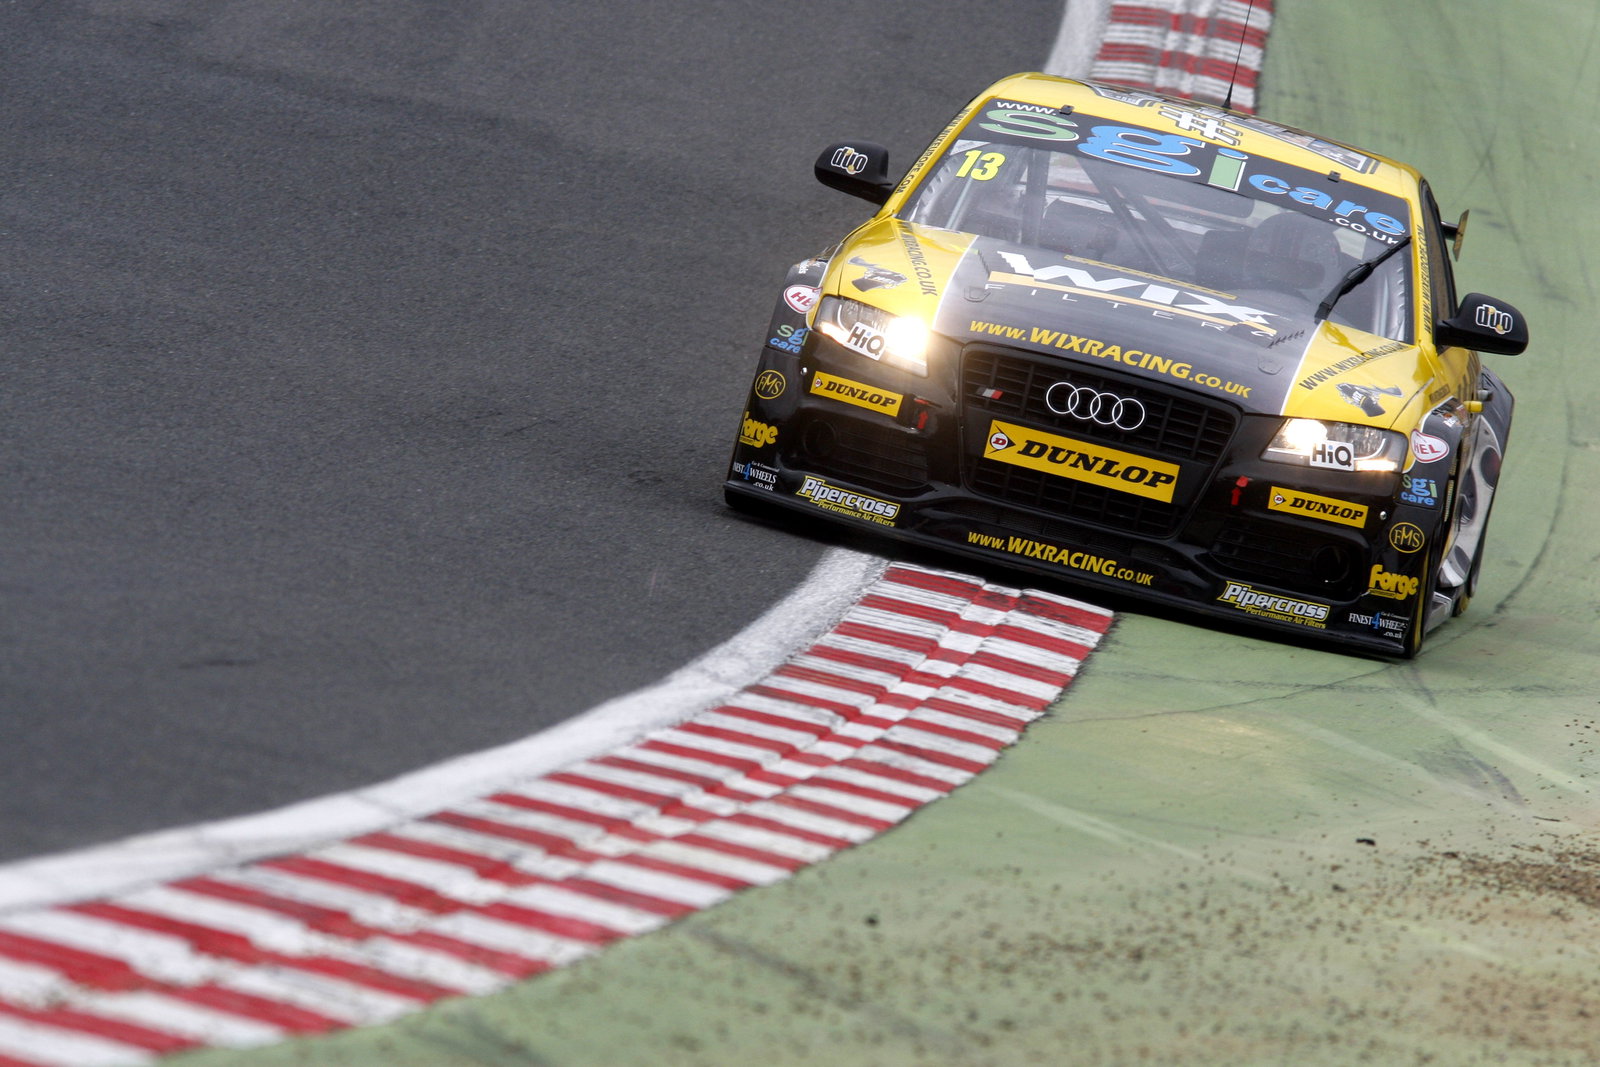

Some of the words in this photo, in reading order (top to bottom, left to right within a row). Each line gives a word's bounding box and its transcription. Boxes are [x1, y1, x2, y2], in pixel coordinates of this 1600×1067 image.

[996, 102, 1056, 115] www.
[956, 150, 1006, 181] 13
[1249, 174, 1406, 235] care
[997, 251, 1282, 325] WIX
[769, 337, 802, 354] care
[846, 326, 885, 357] HiQ
[757, 373, 782, 395] FMS
[825, 380, 897, 408] DUNLOP
[1312, 444, 1352, 467] HiQ
[1413, 443, 1441, 455] HEL
[1017, 439, 1175, 488] DUNLOP
[753, 482, 773, 492] .co.uk
[800, 477, 898, 518] Pipercross
[1401, 490, 1435, 506] care
[817, 501, 864, 518] Performance
[872, 514, 896, 527] Filters
[1289, 496, 1364, 520] DUNLOP
[1393, 526, 1420, 548] FMS
[1223, 583, 1329, 619] Pipercross
[1246, 606, 1293, 622] Performance
[1304, 618, 1326, 629] Filters
